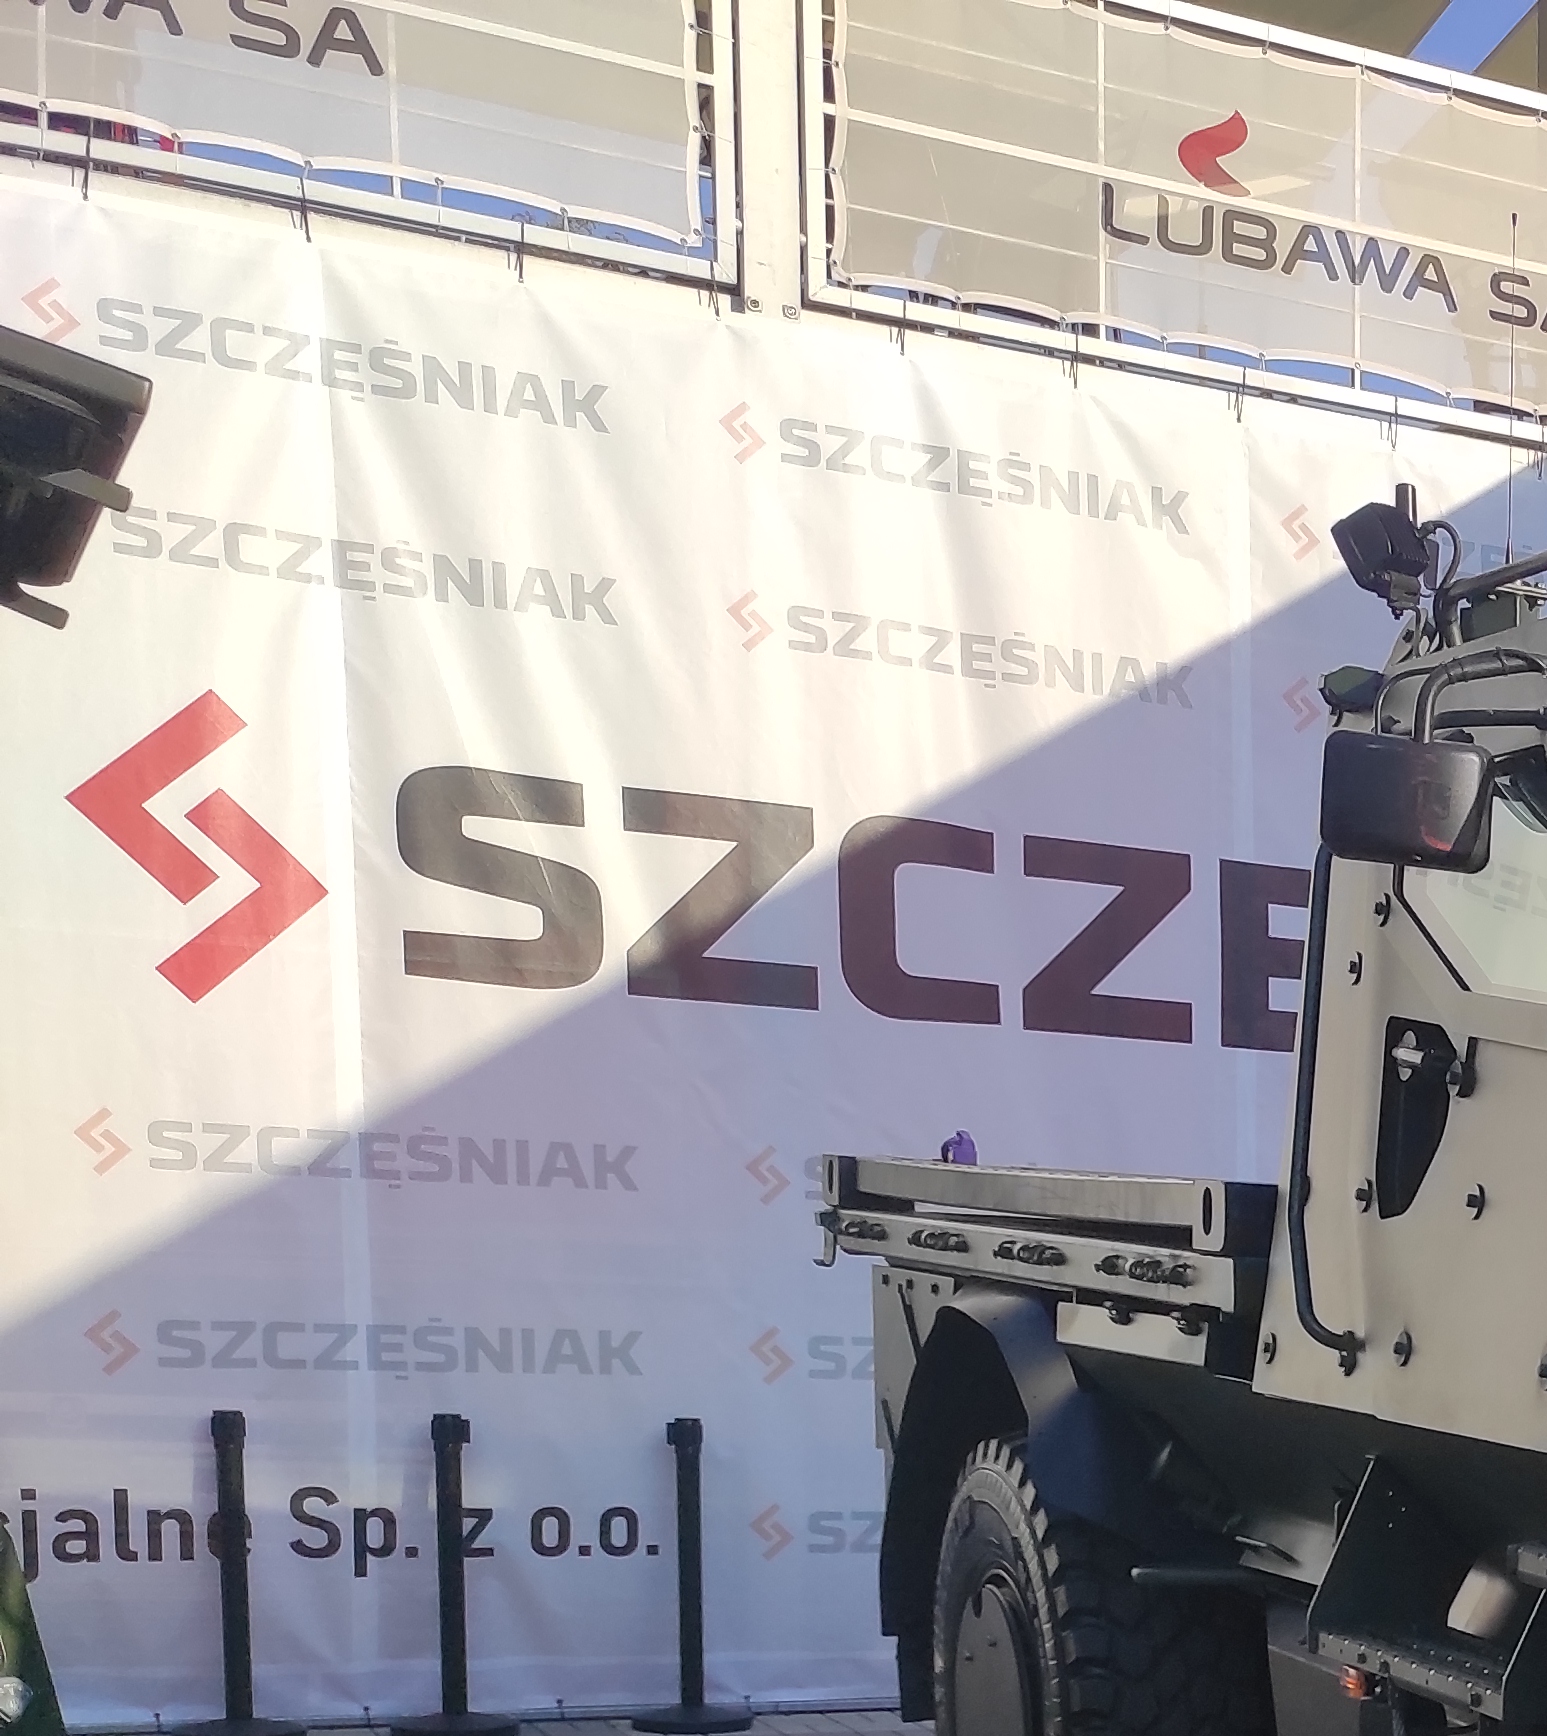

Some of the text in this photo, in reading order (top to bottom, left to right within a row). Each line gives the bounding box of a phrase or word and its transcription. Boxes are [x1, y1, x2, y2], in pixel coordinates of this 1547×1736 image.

[229, 0, 384, 76] SA
[1102, 182, 1458, 313] LUBAWA
[97, 297, 610, 434] SZCZĘŚNIAK
[779, 417, 1189, 536] SZCZĘŚNIAK
[110, 507, 619, 627] SZCZĘŚNIAK
[787, 605, 1193, 710] SZCZĘŚNIAK
[147, 1119, 640, 1193] SZCZĘŚNIAK
[156, 1317, 644, 1380] SZCZĘŚNIAK
[289, 1485, 419, 1578] Sp.
[529, 1505, 661, 1558] o.o.
